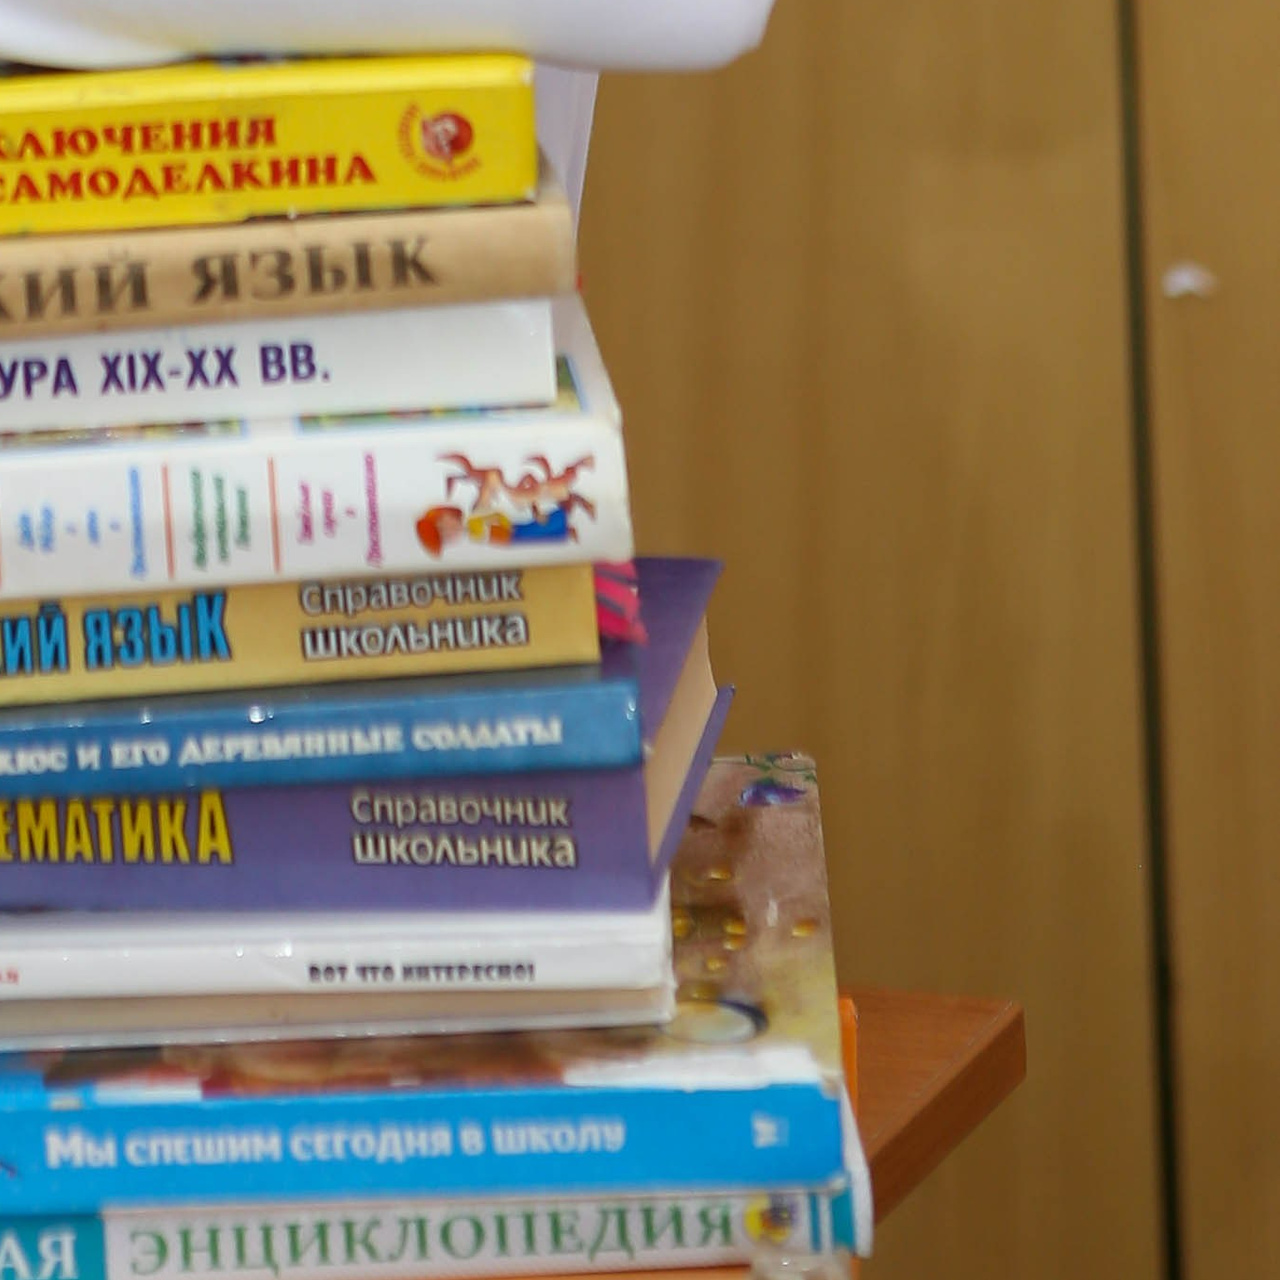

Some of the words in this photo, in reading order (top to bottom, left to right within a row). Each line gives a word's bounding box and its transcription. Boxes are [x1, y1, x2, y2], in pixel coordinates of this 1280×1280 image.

[191, 237, 440, 304] ЯЗЫК
[260, 342, 332, 385] ВВ.
[300, 570, 524, 617] Справочник
[301, 611, 530, 662] школьника
[77, 744, 101, 772] И
[111, 737, 171, 770] ЕГО
[179, 724, 404, 768] ДЕРЕВЯННЫЕ
[412, 716, 563, 752] СОЛДАТЫ
[351, 788, 572, 828] Справочник
[352, 831, 578, 869] школьника
[129, 1198, 736, 1277] ЭНЦИКЛОПЕДИЯ
